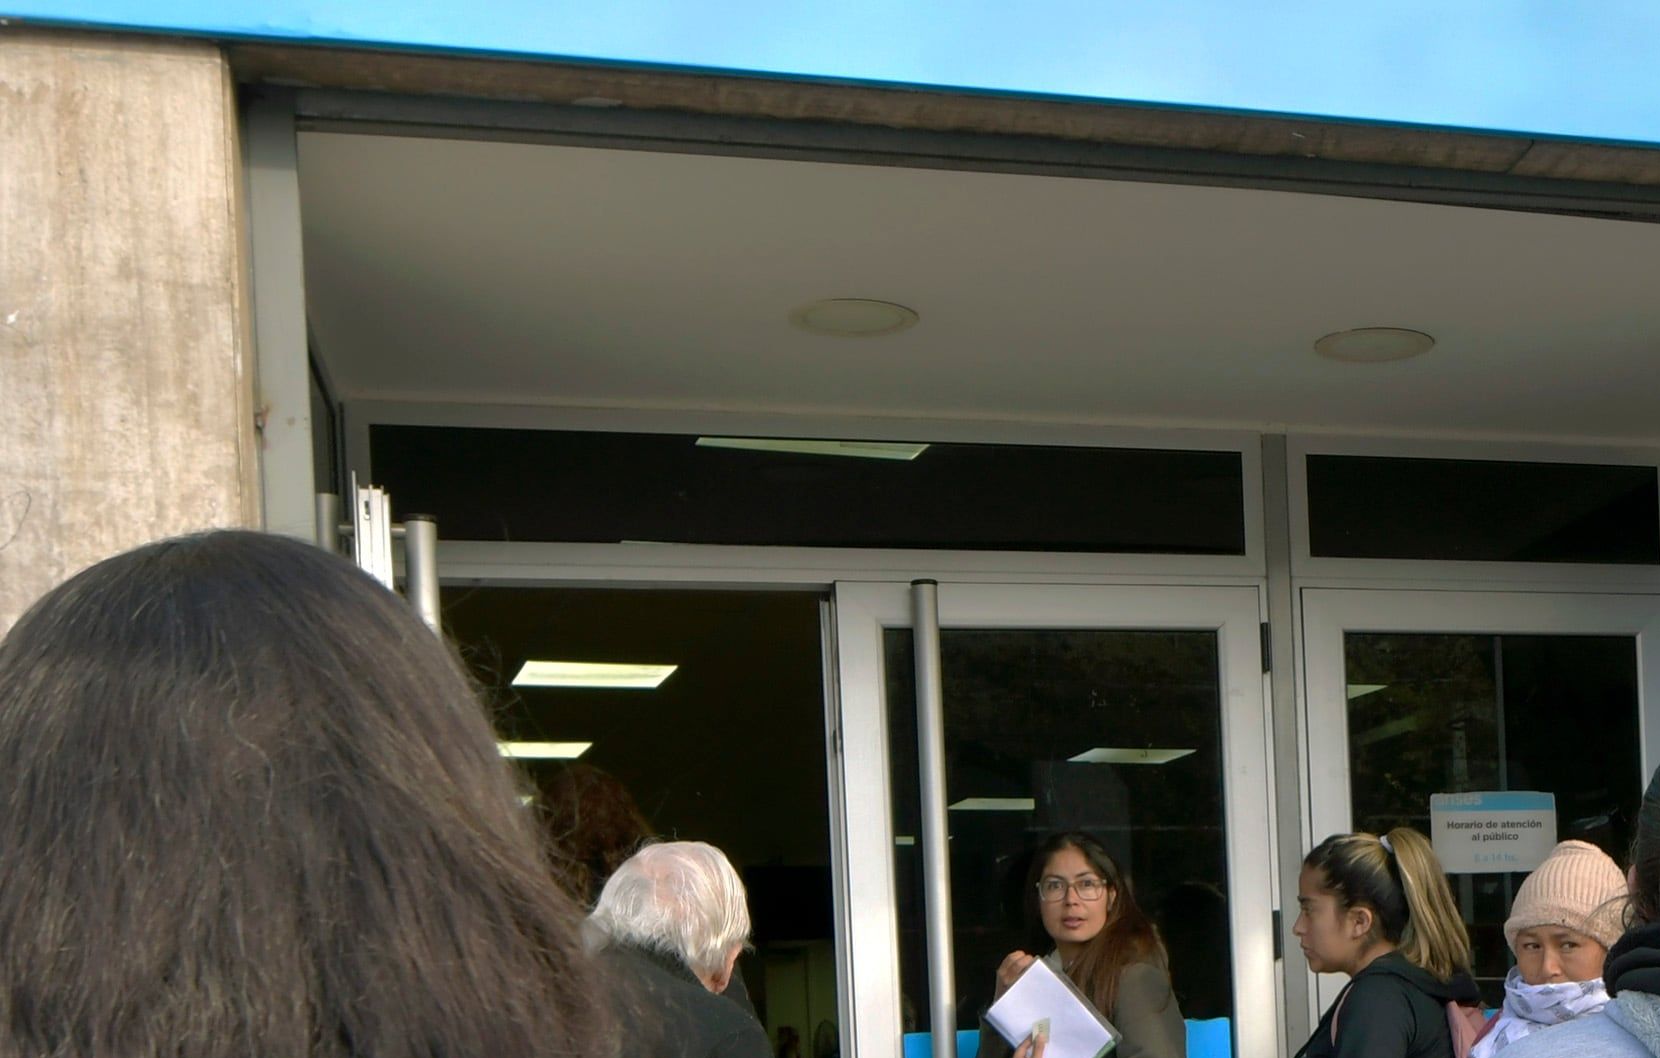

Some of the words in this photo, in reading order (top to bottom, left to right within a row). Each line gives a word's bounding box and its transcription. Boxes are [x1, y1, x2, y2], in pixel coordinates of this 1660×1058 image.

[1447, 820, 1483, 830] Horario
[1486, 819, 1499, 829] de
[1501, 819, 1543, 829] atención
[1471, 832, 1481, 842] al
[1483, 831, 1519, 843] público
